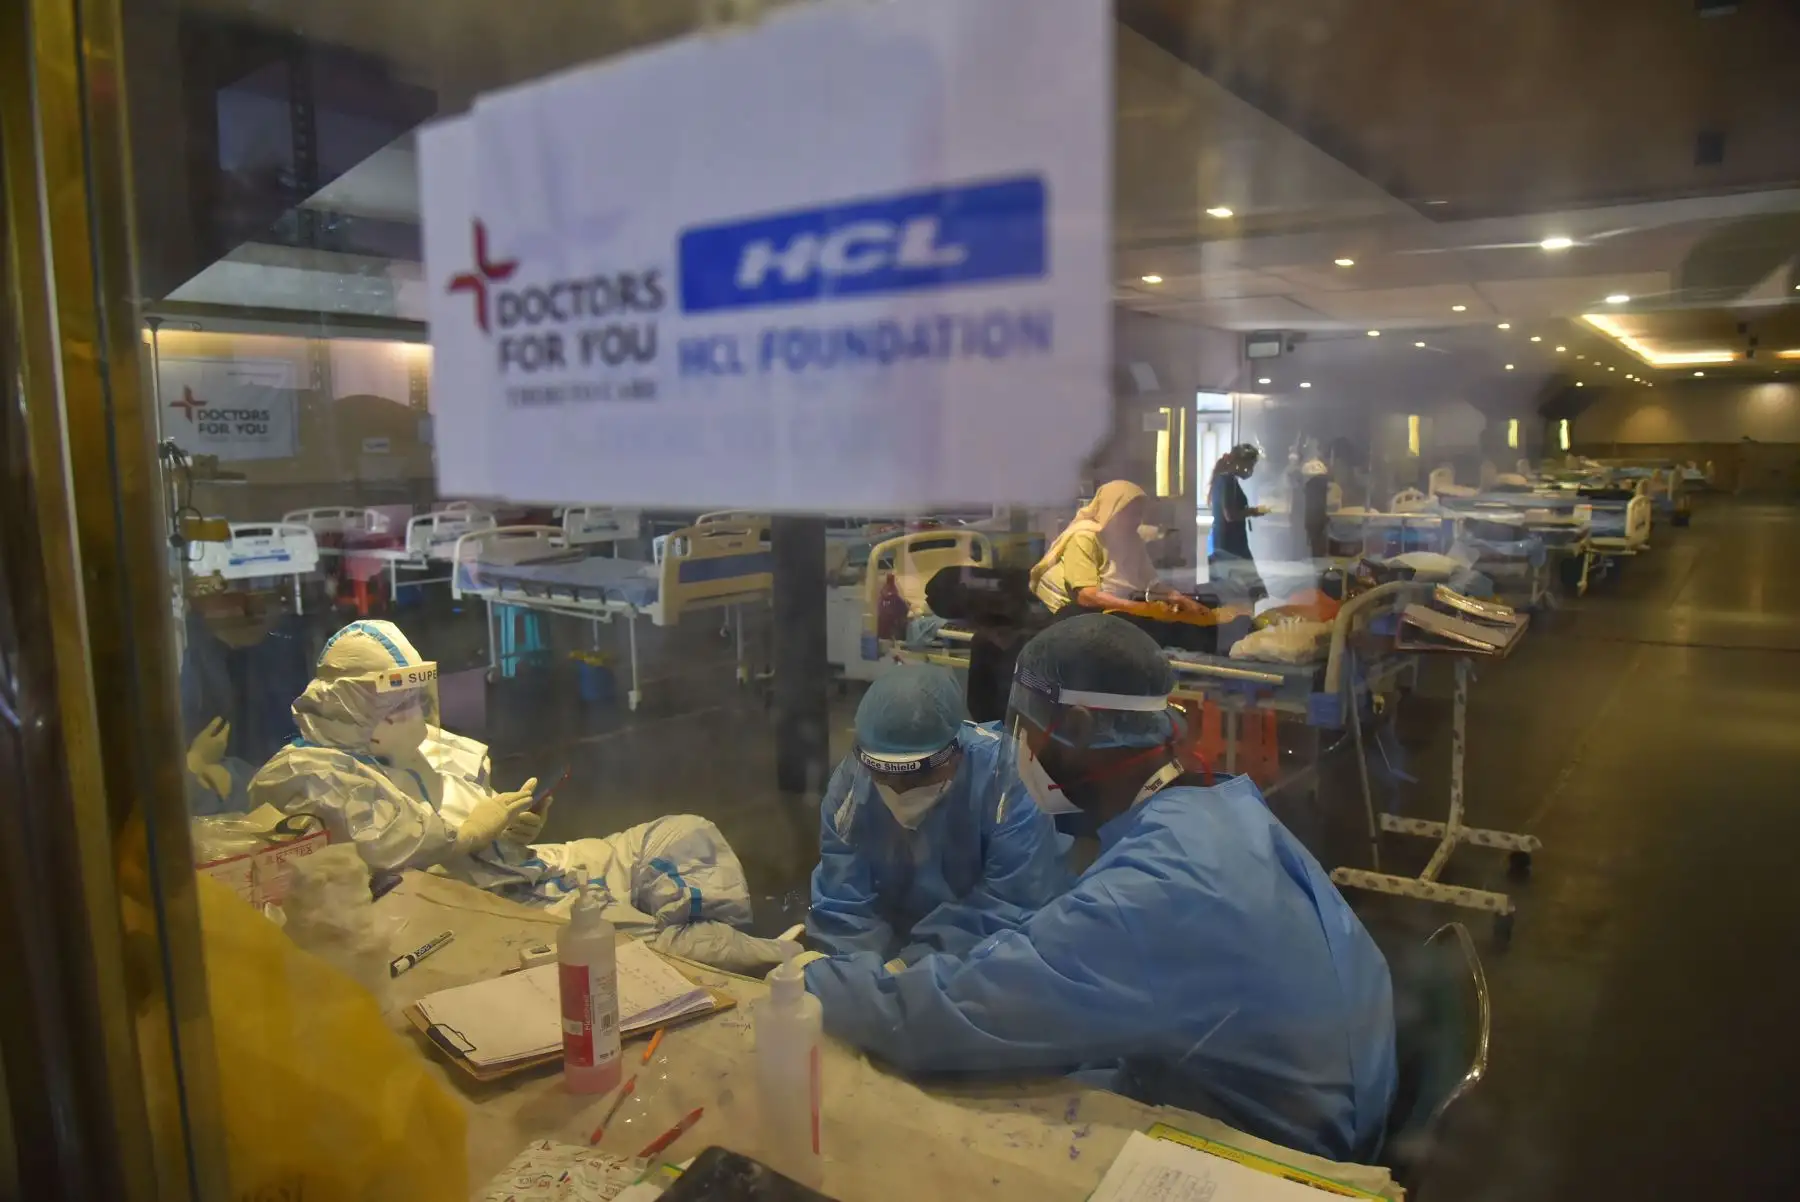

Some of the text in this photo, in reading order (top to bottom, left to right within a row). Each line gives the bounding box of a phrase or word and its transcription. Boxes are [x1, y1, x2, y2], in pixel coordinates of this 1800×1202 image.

[737, 216, 966, 287] HCL
[497, 268, 666, 329] DOCTORS
[498, 321, 658, 374] FOR YOU
[679, 308, 1053, 376] HCL FOUNDATION
[197, 409, 270, 421] DOCTORS
[198, 422, 267, 435] FOR YOU
[884, 762, 916, 772] Shield
